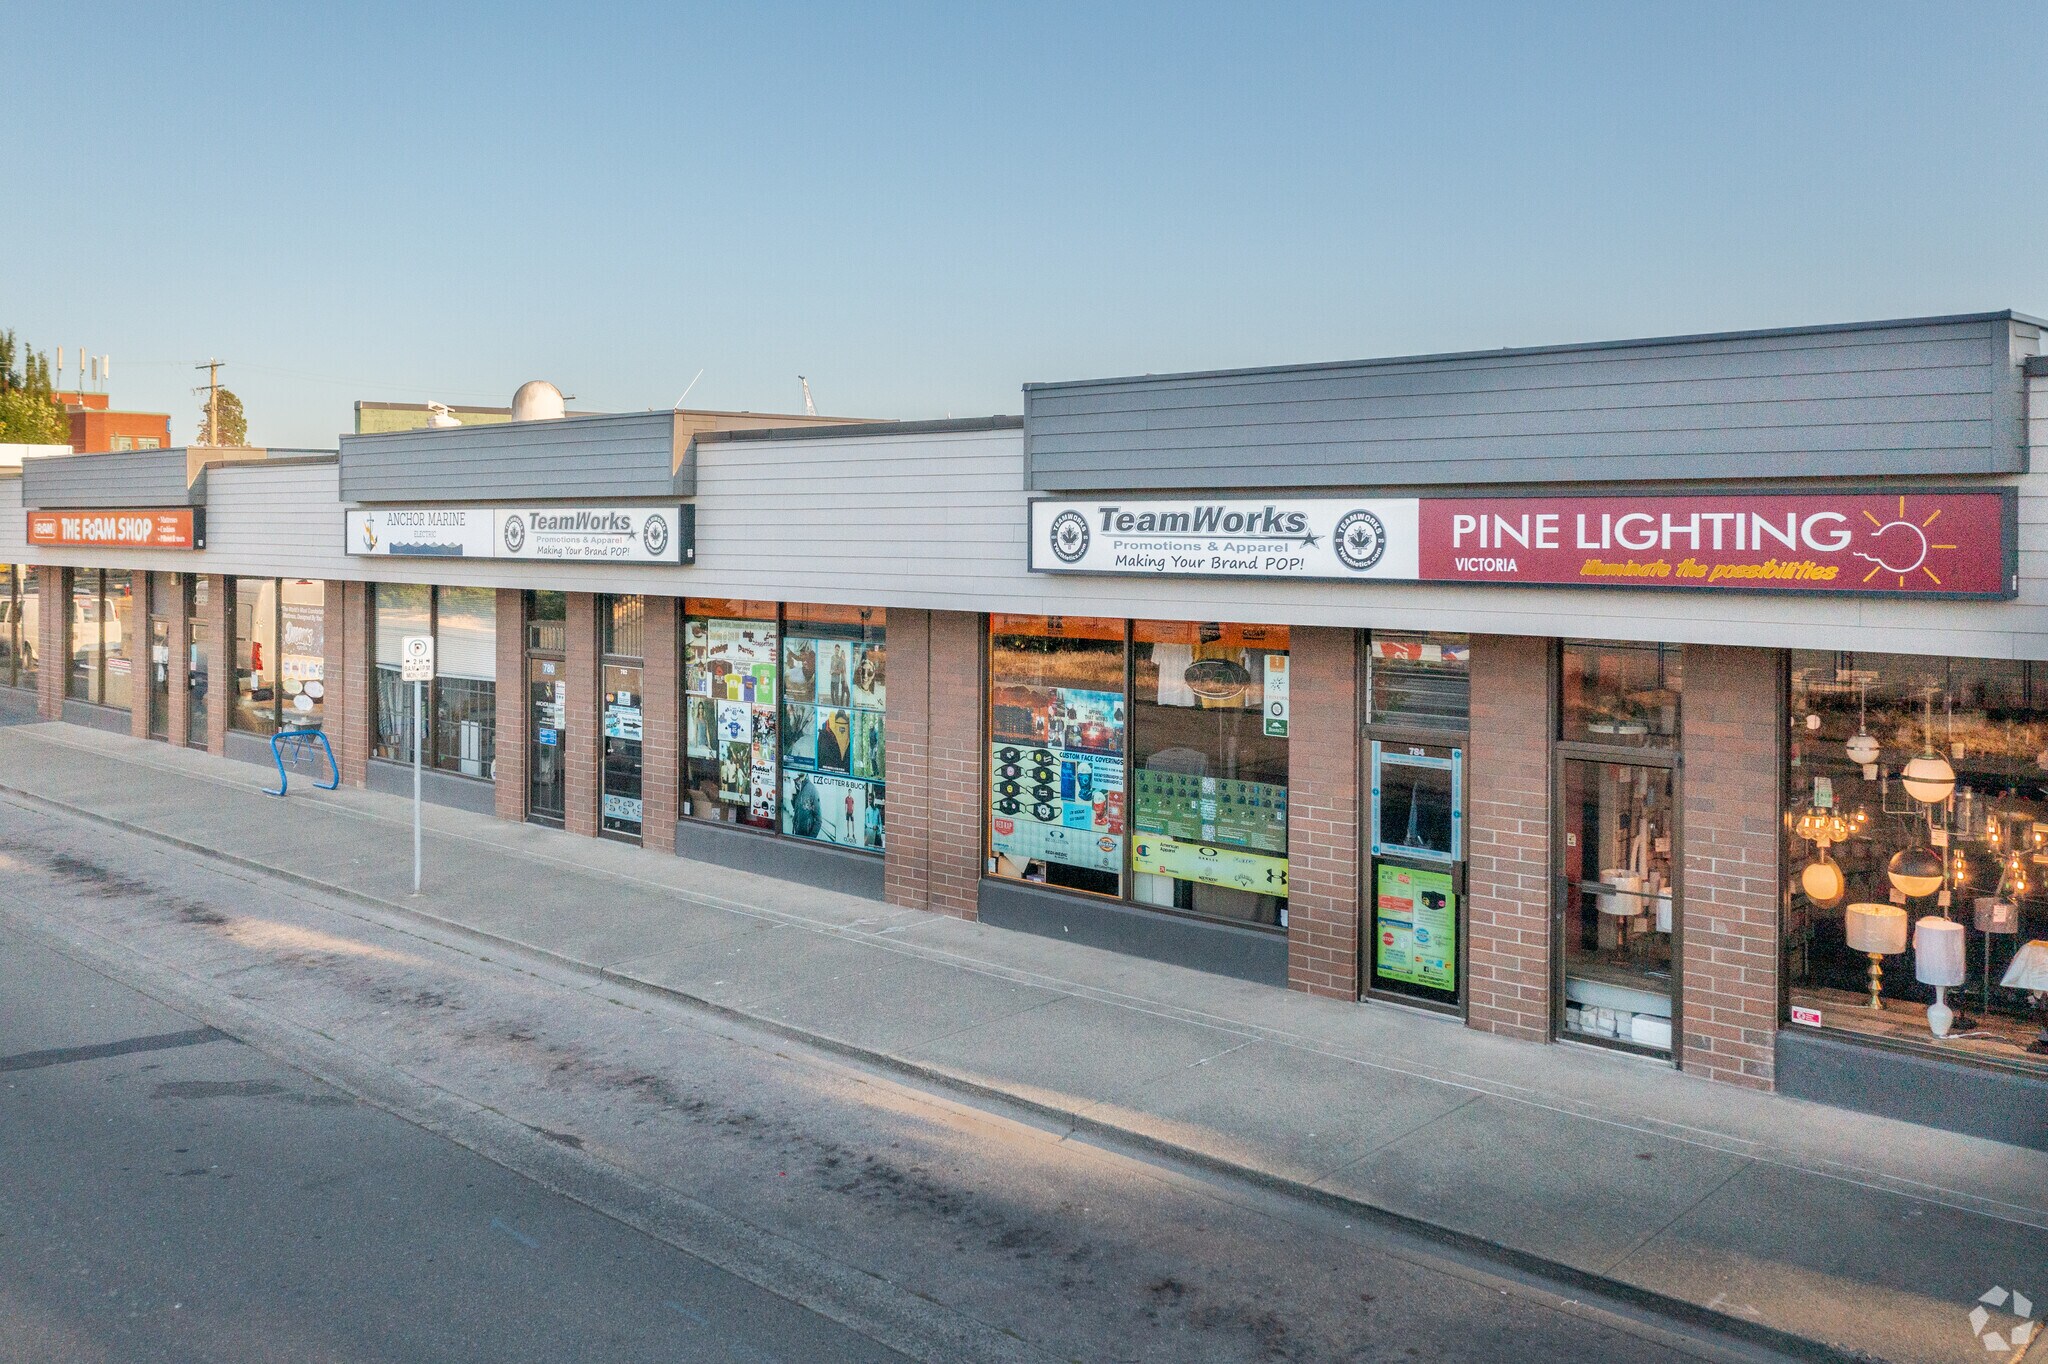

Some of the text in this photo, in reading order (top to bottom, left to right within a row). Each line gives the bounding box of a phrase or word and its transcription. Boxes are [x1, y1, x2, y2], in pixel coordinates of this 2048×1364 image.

[387, 512, 466, 526] ANCHOR MARINE
[529, 511, 630, 530] TeamWorks
[1053, 513, 1087, 532] TEAMWORKS
[1098, 505, 1308, 533] TeamWorks
[1337, 513, 1383, 534] TEAMWORKS
[61, 517, 153, 542] THE FOAM SHOP
[413, 530, 437, 538] ELECTRIC
[1453, 511, 1852, 552] PINE LIGHTING
[536, 535, 623, 546] Promotions & Apparel
[1113, 540, 1289, 554] Promotions & Apparel
[536, 546, 630, 558] Making Your Brand POP!
[1338, 546, 1383, 568] TWathletics.com
[1115, 553, 1305, 572] Making Your Brand POP!
[1454, 557, 1519, 572] VICTORIA
[1580, 558, 1840, 583] illuminate the possibilities
[543, 663, 555, 674] 780
[1060, 752, 1123, 765] CUSTOM FACE COVERINGS
[824, 778, 845, 787] CUTTER
